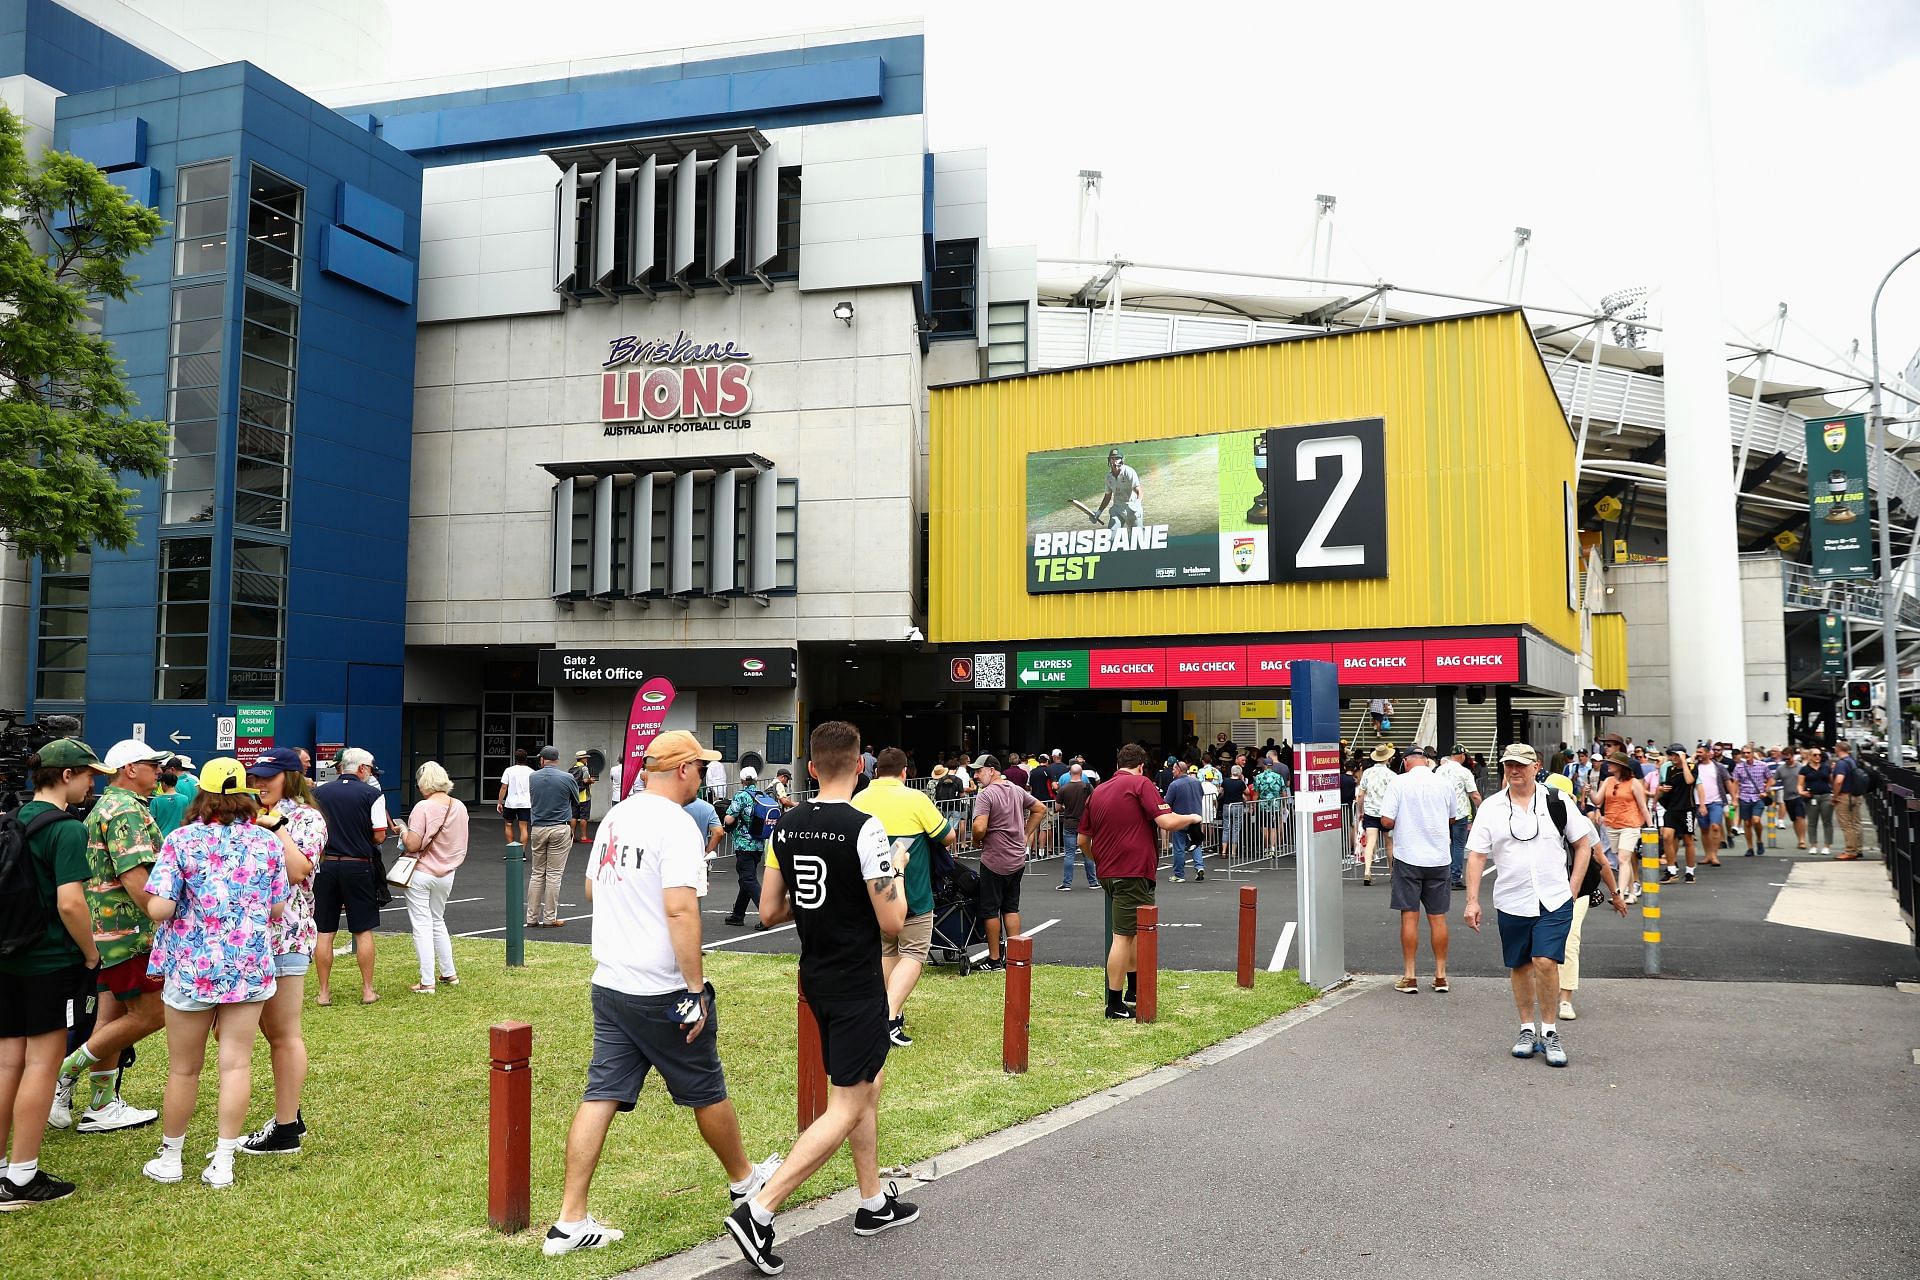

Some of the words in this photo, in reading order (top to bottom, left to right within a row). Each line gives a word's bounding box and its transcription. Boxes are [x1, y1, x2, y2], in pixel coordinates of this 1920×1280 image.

[602, 330, 751, 367] Brisbane
[600, 363, 752, 421] LIONS
[604, 425, 664, 436] AUSTRALIAN
[668, 422, 720, 432] FOOTBALL
[724, 419, 751, 430] CLUB
[1296, 435, 1365, 568] 2
[1033, 524, 1169, 556] BRISBANE
[1035, 556, 1100, 582] TEST
[563, 655, 587, 665] Gate
[589, 655, 596, 665] 2
[1033, 660, 1072, 669] EXPRESS
[1260, 661, 1282, 670] BAG
[1343, 658, 1367, 668] BAG
[1369, 657, 1407, 667] CHECK
[1436, 656, 1460, 666] BAG
[1463, 655, 1503, 665] CHECK
[1100, 665, 1120, 673] BAG
[1122, 664, 1154, 673] CHECK
[1179, 663, 1200, 671] BAG
[1202, 662, 1236, 671] CHECK
[563, 668, 602, 680] Ticket
[605, 668, 643, 680] Office
[1042, 672, 1066, 681] LANE
[222, 722, 231, 733] 10
[631, 722, 662, 730] EXPRESS
[788, 832, 845, 842] RICCIARDO
[793, 855, 827, 909] 3
